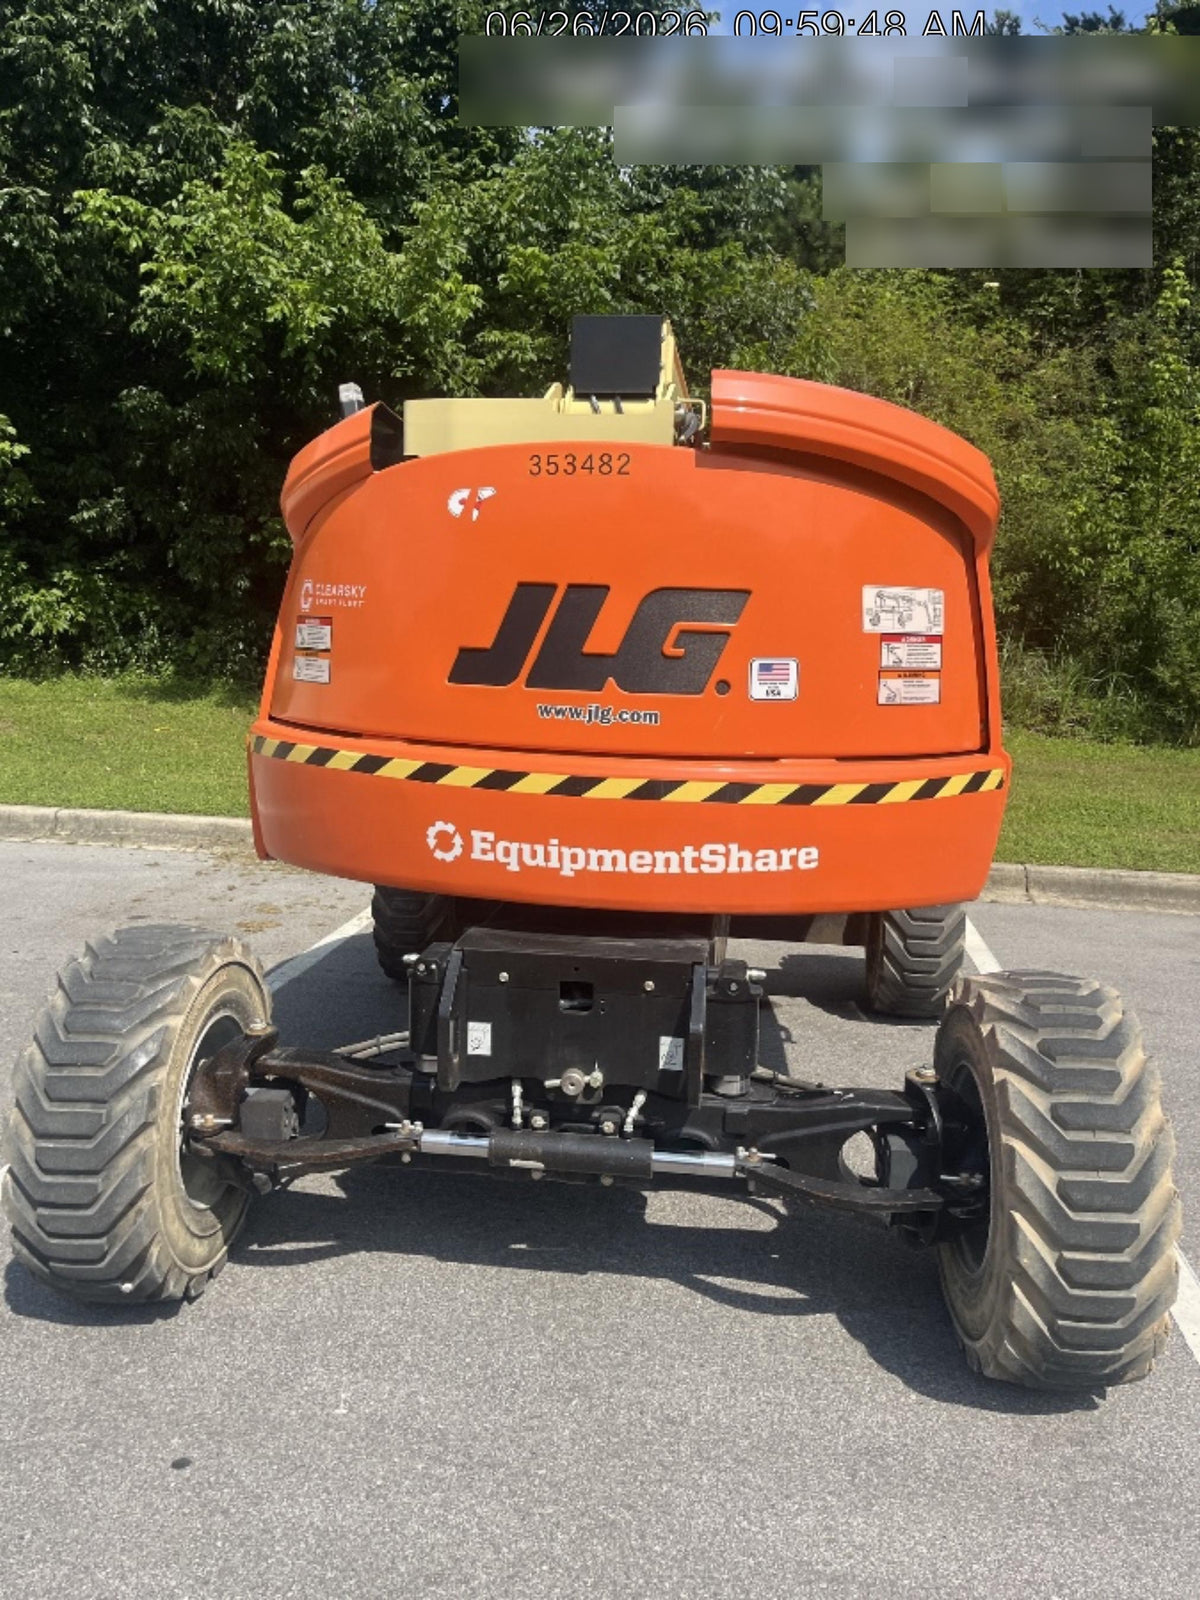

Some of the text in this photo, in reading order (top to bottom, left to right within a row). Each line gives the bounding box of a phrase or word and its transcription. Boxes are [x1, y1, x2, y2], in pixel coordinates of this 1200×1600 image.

[528, 453, 631, 476] 353482
[537, 704, 660, 725] www.jlg.com
[470, 829, 819, 877] EquipmentShare
